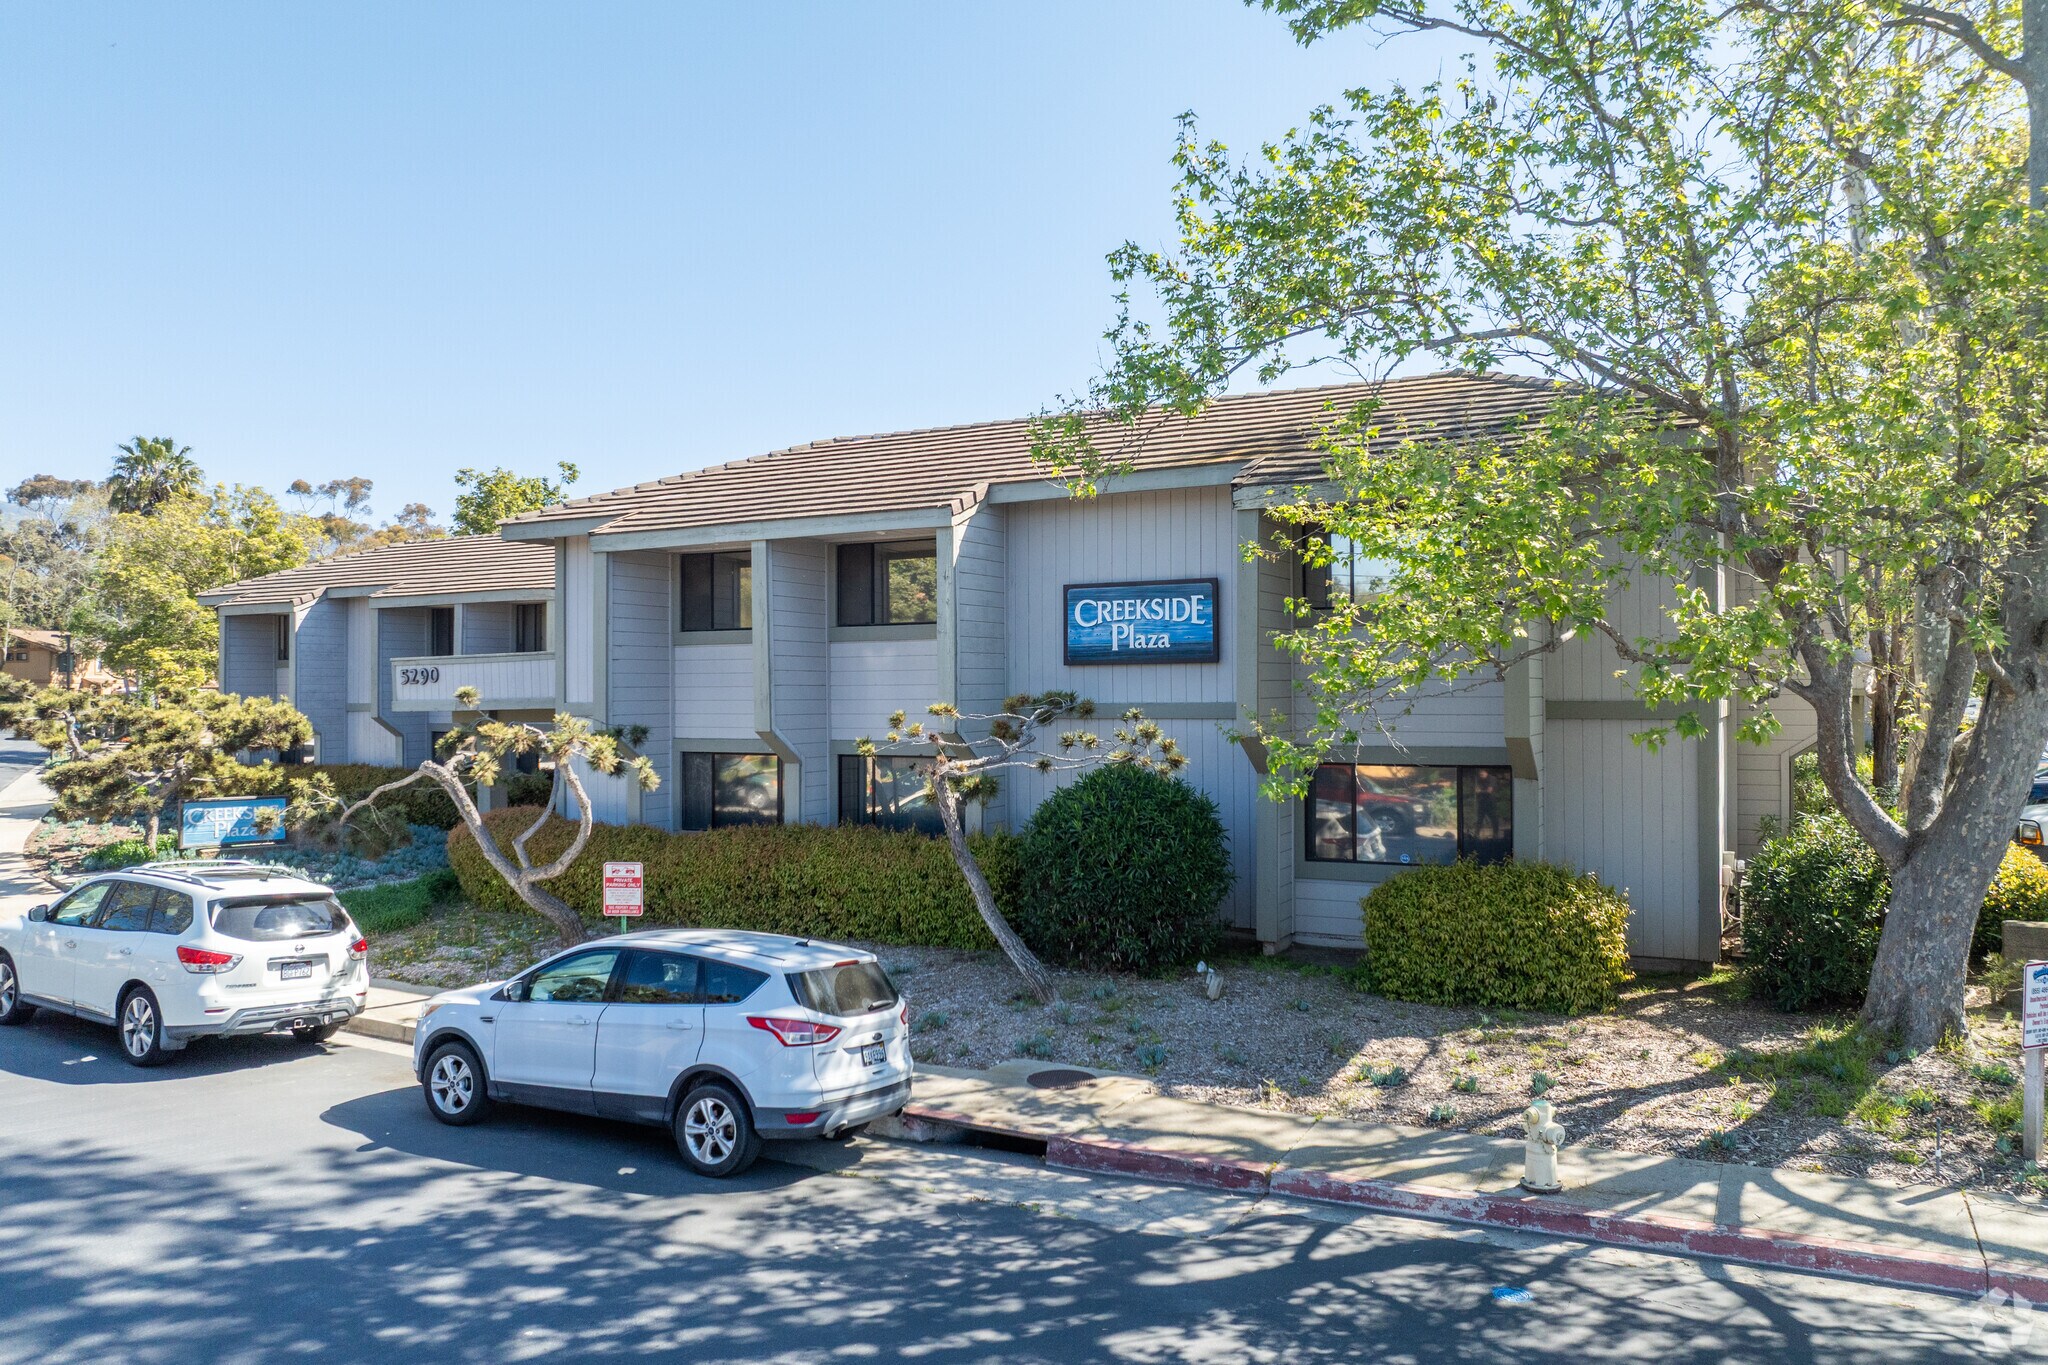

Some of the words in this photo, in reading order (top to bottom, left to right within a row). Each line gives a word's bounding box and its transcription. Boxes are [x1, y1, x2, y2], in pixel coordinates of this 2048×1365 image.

[1074, 594, 1206, 628] CREEKSIDE
[1111, 623, 1171, 651] Plaza
[400, 666, 439, 686] 5290
[187, 804, 279, 826] CREEKSI
